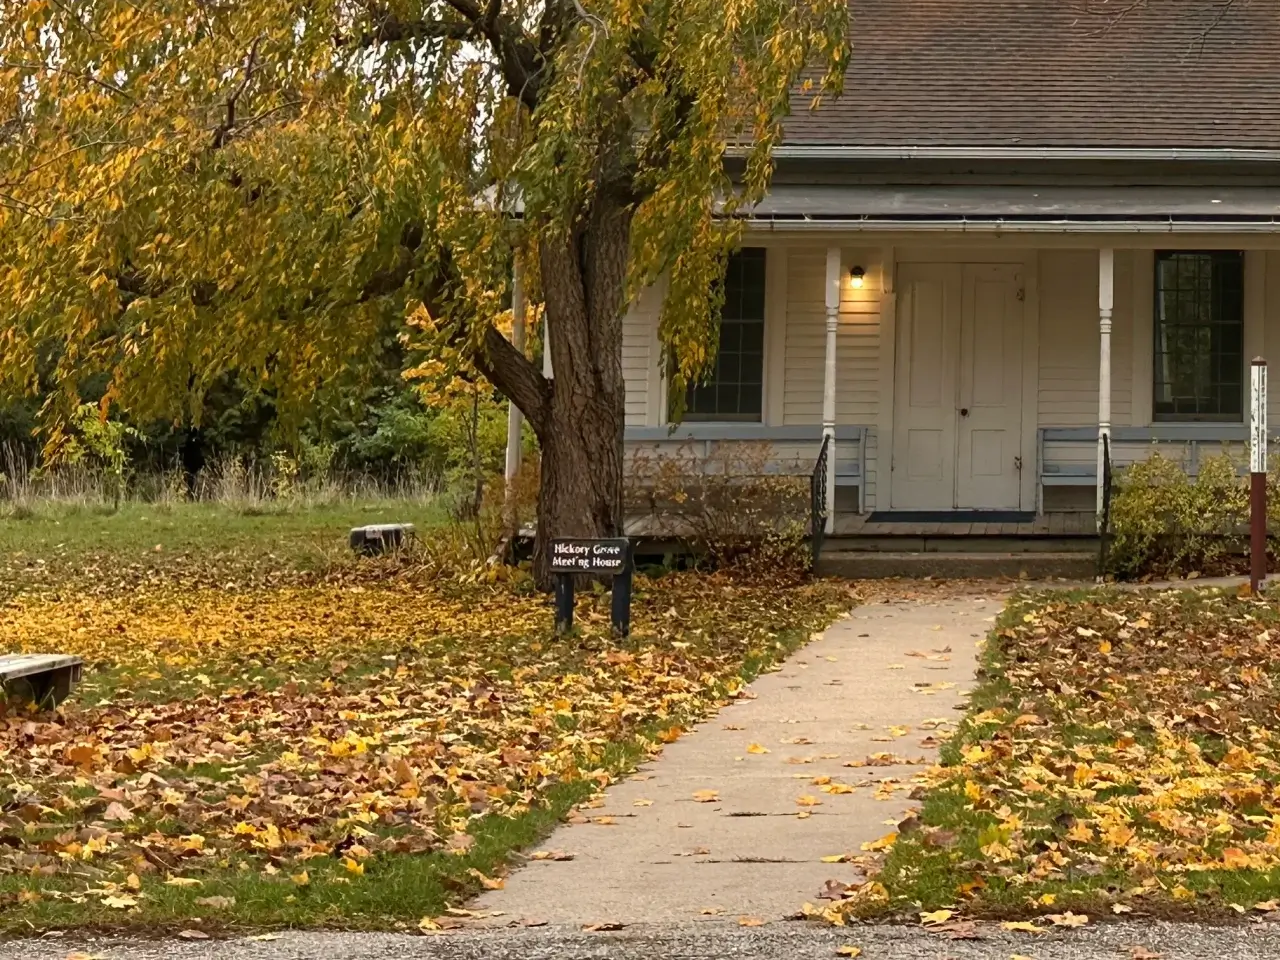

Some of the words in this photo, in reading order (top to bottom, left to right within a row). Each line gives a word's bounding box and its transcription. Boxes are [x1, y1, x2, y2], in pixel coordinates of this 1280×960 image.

[554, 543, 590, 556] Hickory
[552, 556, 590, 569] Meeting
[592, 557, 621, 567] House
